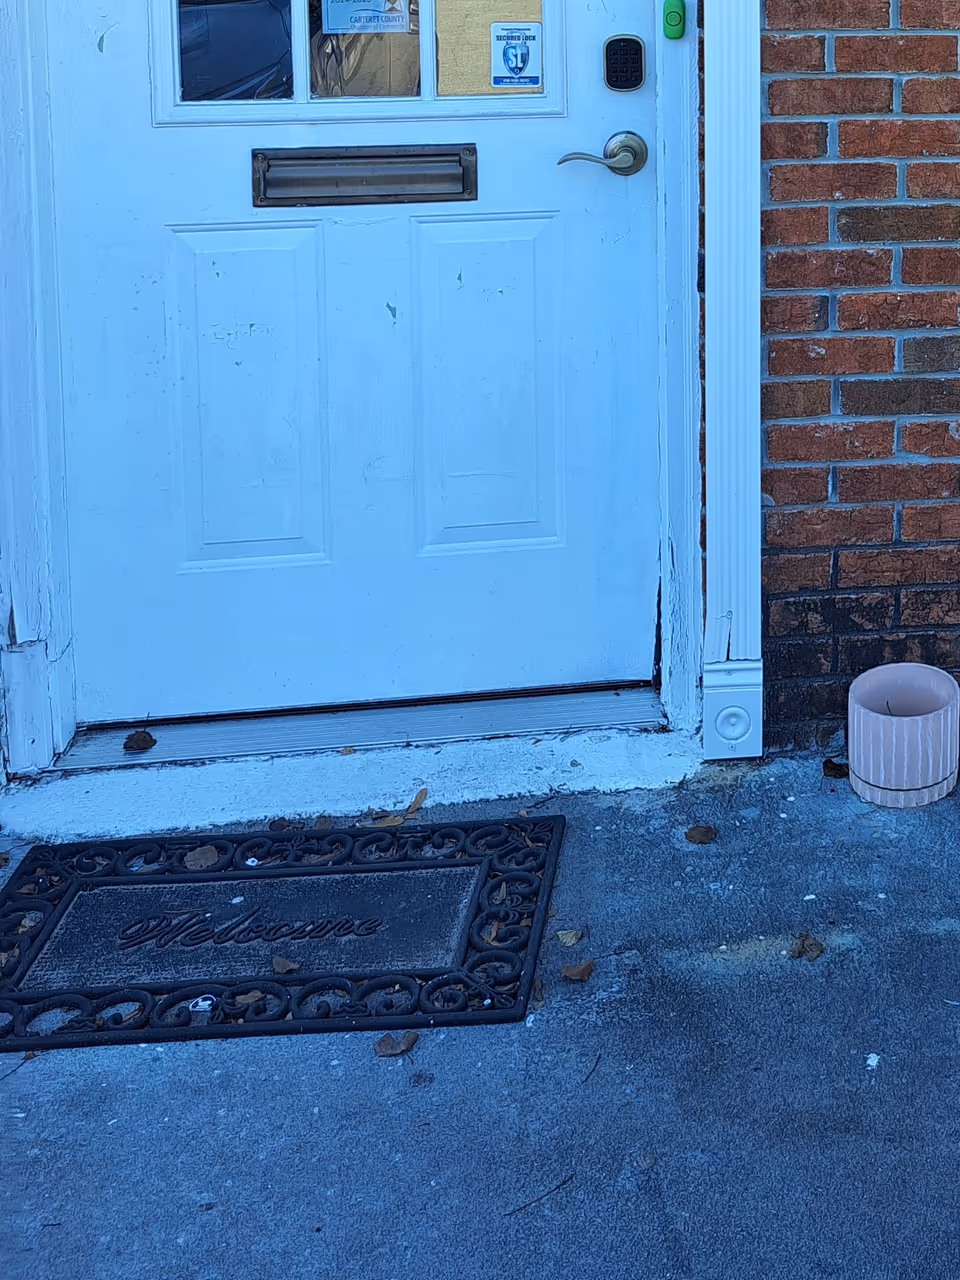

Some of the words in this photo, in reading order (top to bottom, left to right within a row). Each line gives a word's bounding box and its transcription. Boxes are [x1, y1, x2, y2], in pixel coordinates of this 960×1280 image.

[349, 15, 380, 24] CARTERET
[381, 15, 405, 23] COUNTY
[495, 34, 521, 42] SECURED
[522, 34, 537, 42] LOCK
[508, 46, 523, 68] SL
[118, 906, 383, 952] Welcome
